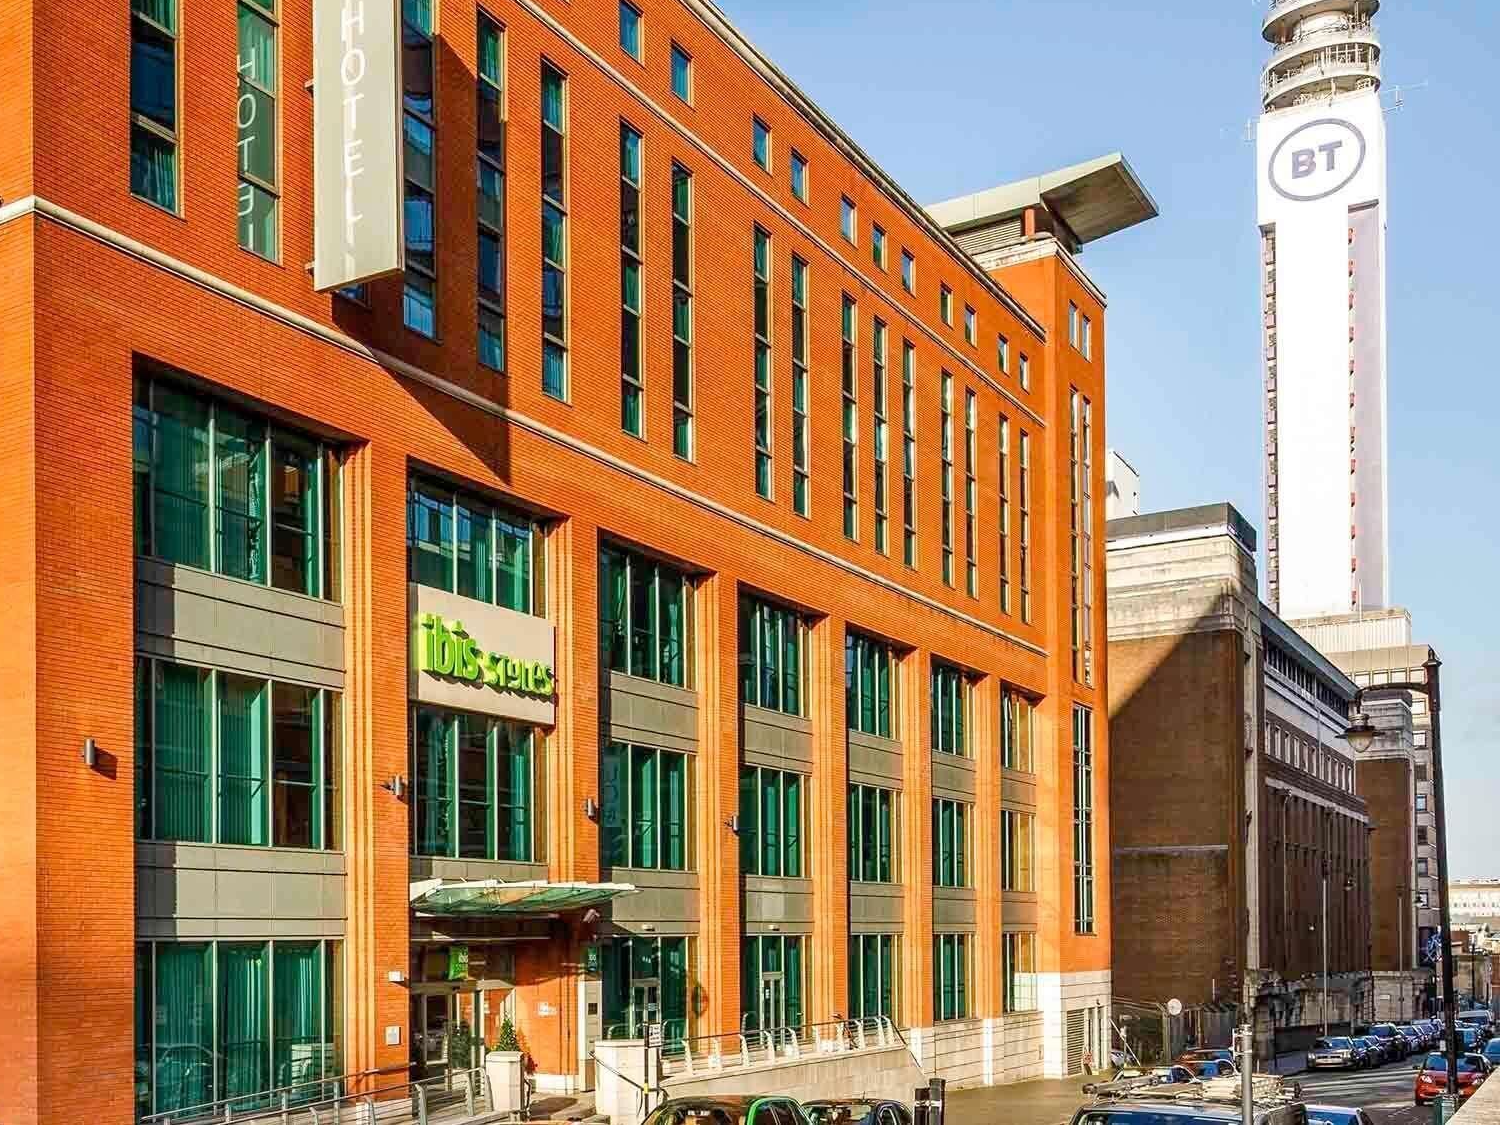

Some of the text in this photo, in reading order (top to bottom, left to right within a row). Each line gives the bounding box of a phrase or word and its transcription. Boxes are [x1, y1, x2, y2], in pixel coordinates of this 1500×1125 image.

[341, 0, 366, 226] HOTEL
[1291, 139, 1343, 180] BT
[418, 612, 480, 680] ibis
